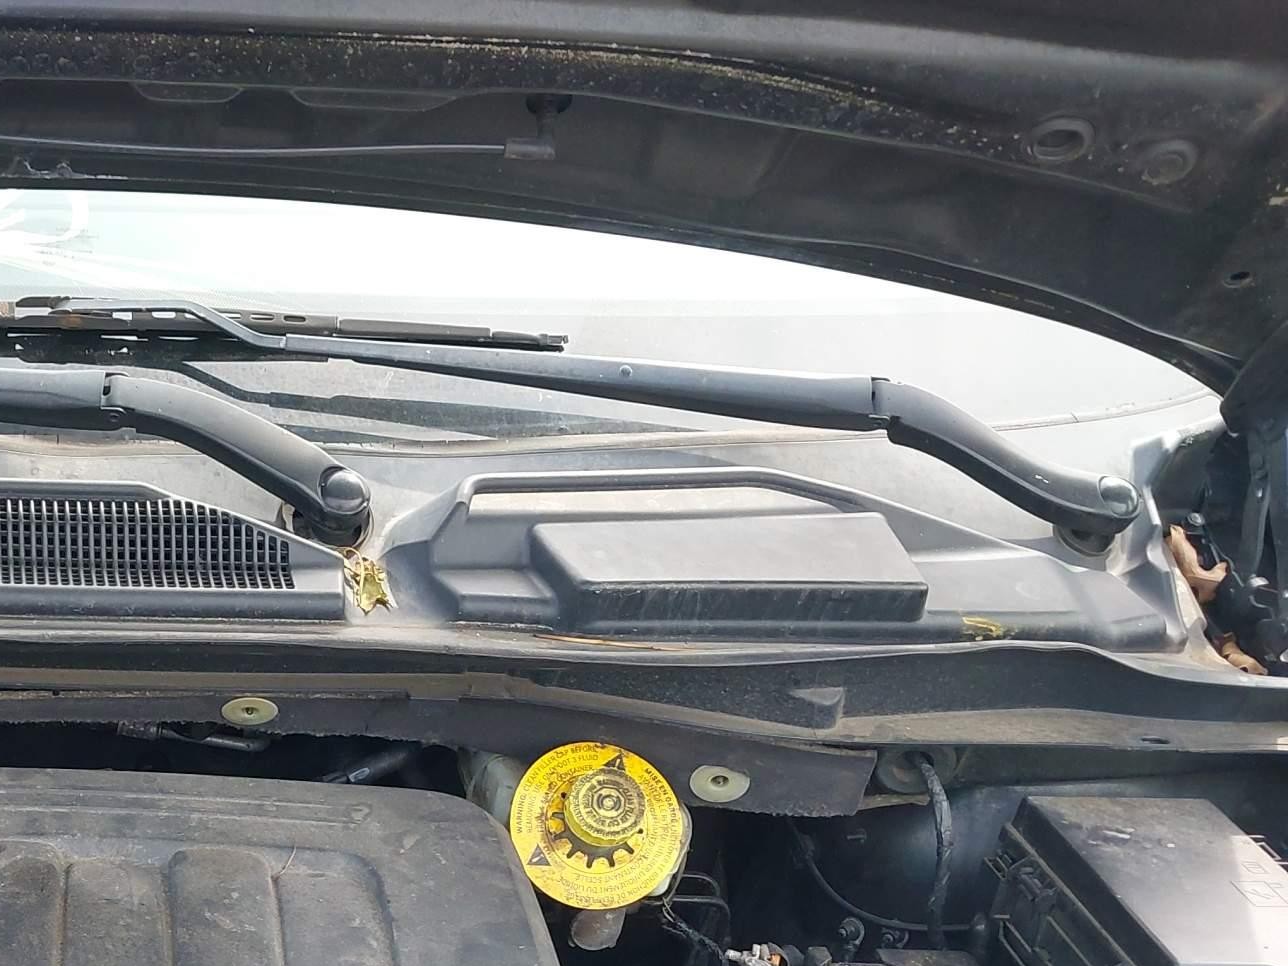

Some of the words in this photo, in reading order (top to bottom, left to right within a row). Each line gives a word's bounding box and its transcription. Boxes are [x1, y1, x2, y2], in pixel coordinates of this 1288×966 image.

[576, 753, 598, 762] FLUID
[521, 768, 540, 792] CLEAN
[535, 754, 557, 773] FILLER
[643, 766, 662, 787] MISE
